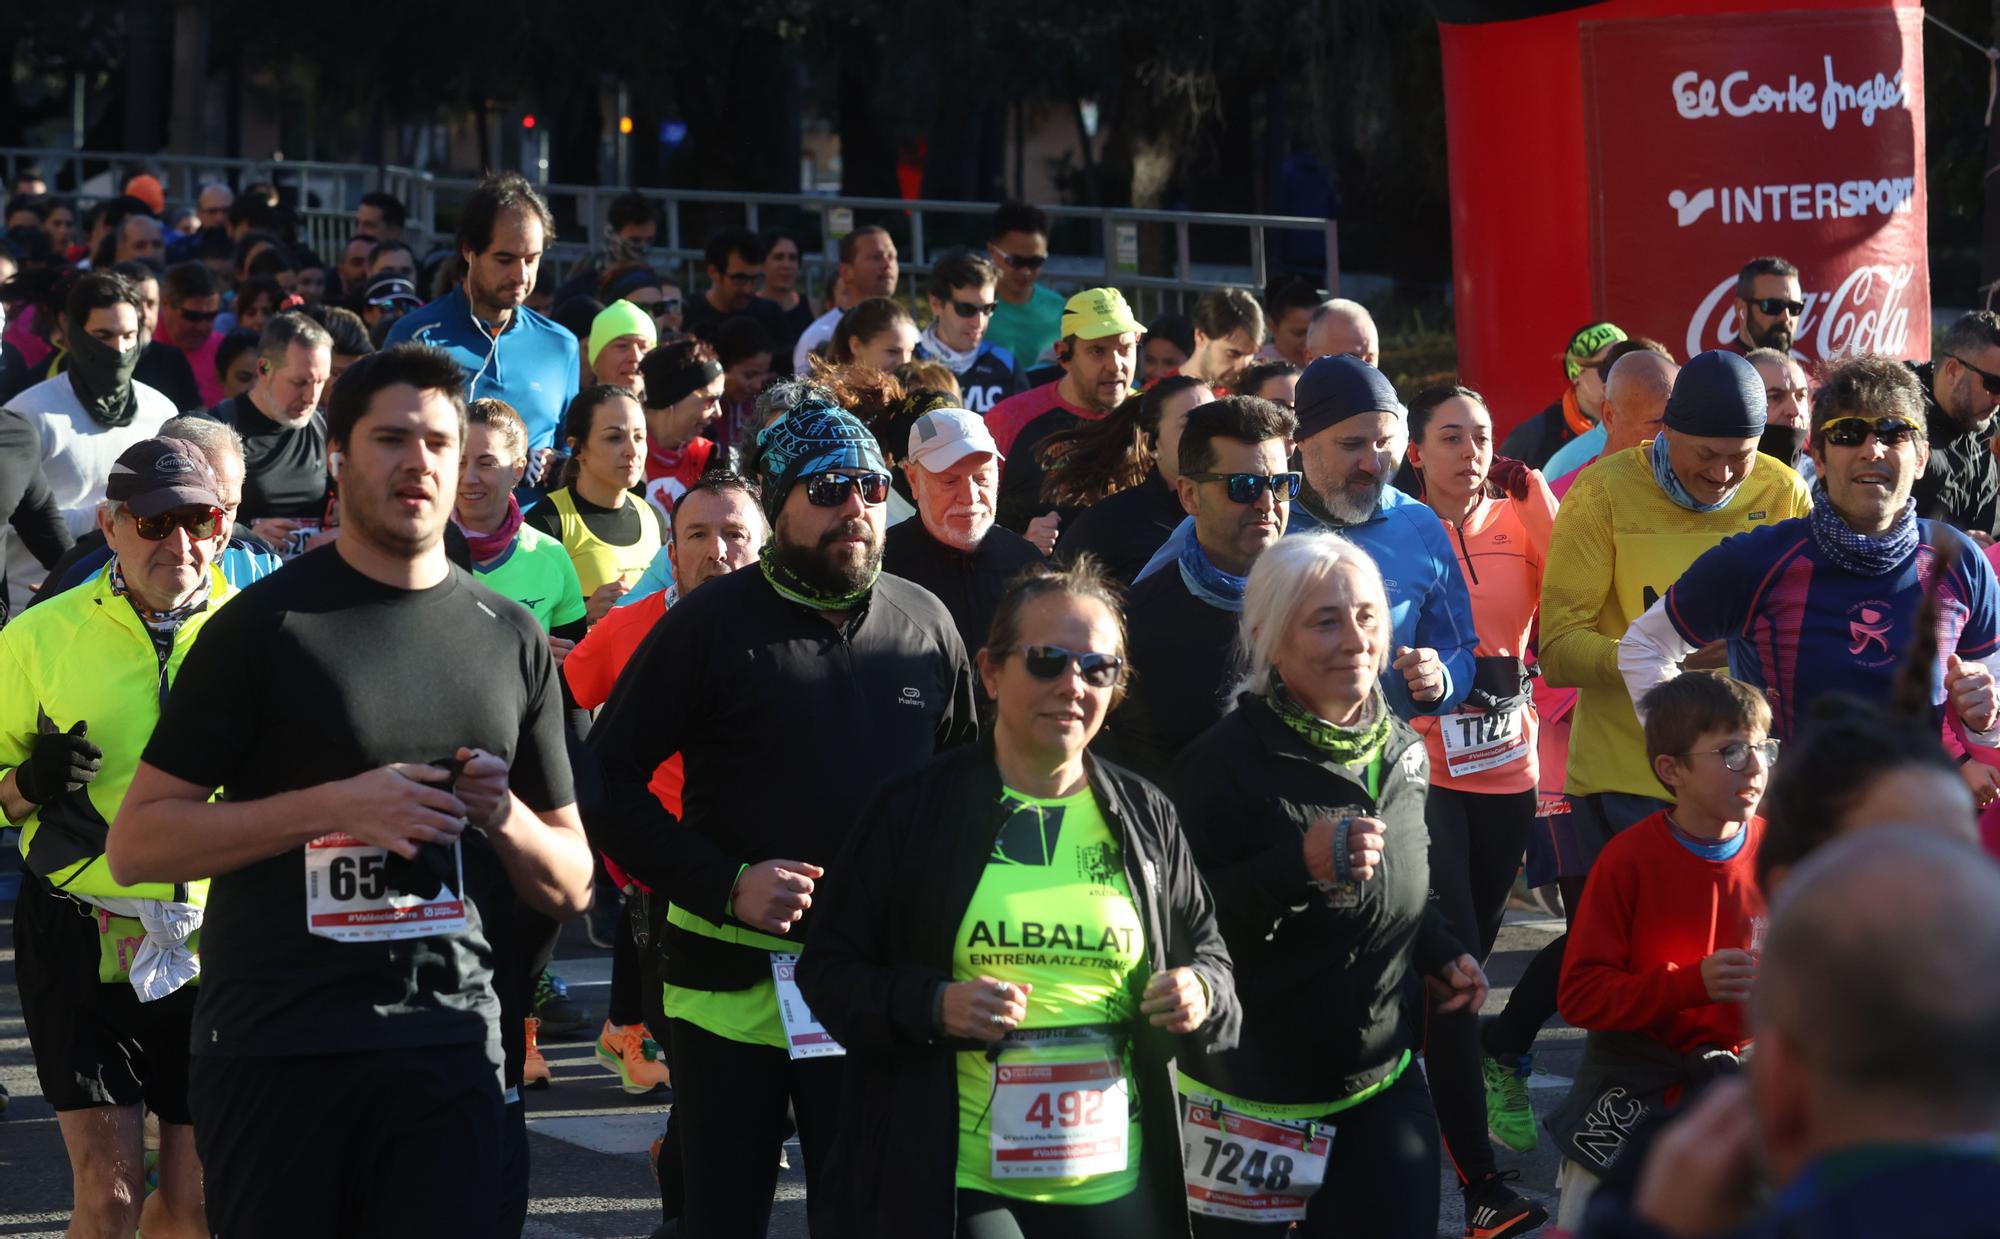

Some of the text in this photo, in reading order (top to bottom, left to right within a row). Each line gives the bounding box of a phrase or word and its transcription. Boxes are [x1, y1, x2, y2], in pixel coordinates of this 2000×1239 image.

[1672, 70, 1719, 120] El
[1719, 70, 1817, 117] Corte
[1721, 175, 1914, 224] INTERSPORT
[1456, 712, 1511, 747] 7722
[330, 855, 387, 901] 65
[967, 920, 1135, 953] ALBALAT
[970, 953, 1046, 966] ENTRENA
[1025, 1089, 1103, 1129] 492
[1573, 1087, 1641, 1166] NYC
[1200, 1136, 1294, 1191] 7248
